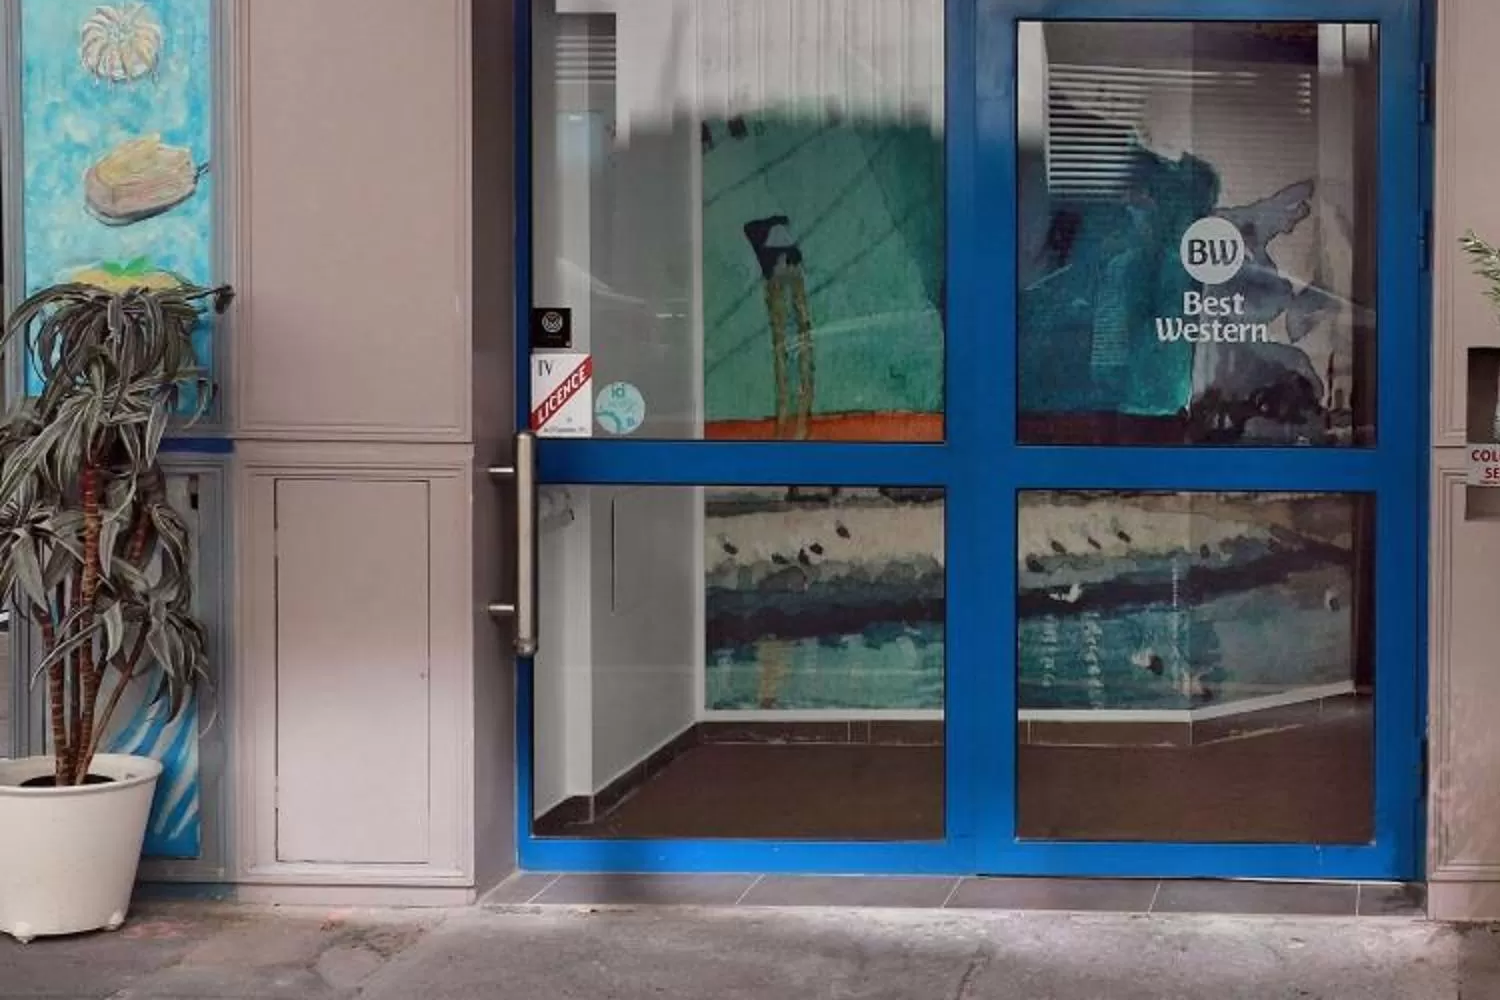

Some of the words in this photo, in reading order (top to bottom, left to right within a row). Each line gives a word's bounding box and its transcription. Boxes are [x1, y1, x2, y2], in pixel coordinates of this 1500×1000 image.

[1187, 238, 1239, 266] BW
[1183, 291, 1245, 317] Best
[1155, 317, 1270, 343] Western
[537, 359, 554, 377] IV
[537, 364, 587, 425] LICENCE
